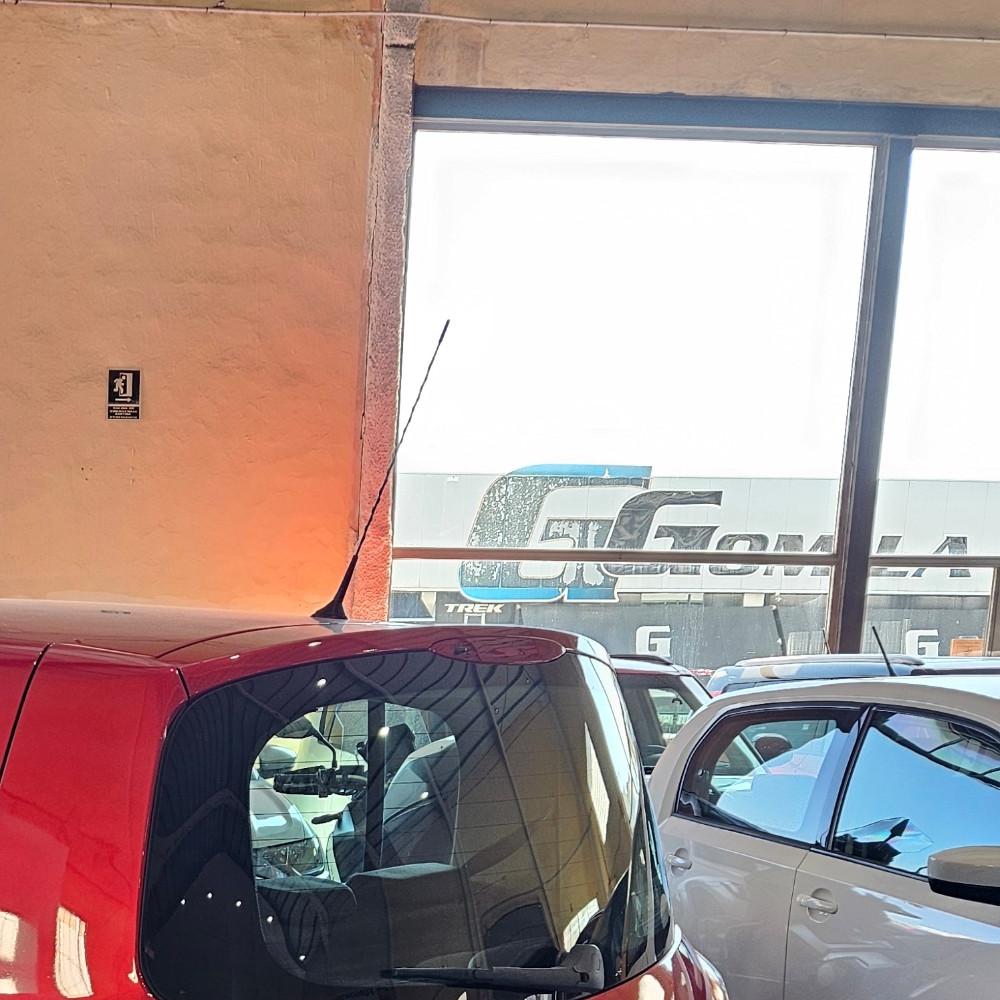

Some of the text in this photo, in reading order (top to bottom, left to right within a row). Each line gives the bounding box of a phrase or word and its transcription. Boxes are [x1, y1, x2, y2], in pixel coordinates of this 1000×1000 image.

[601, 489, 973, 577] GOMLA
[444, 603, 506, 613] TREK
[635, 625, 672, 658] G
